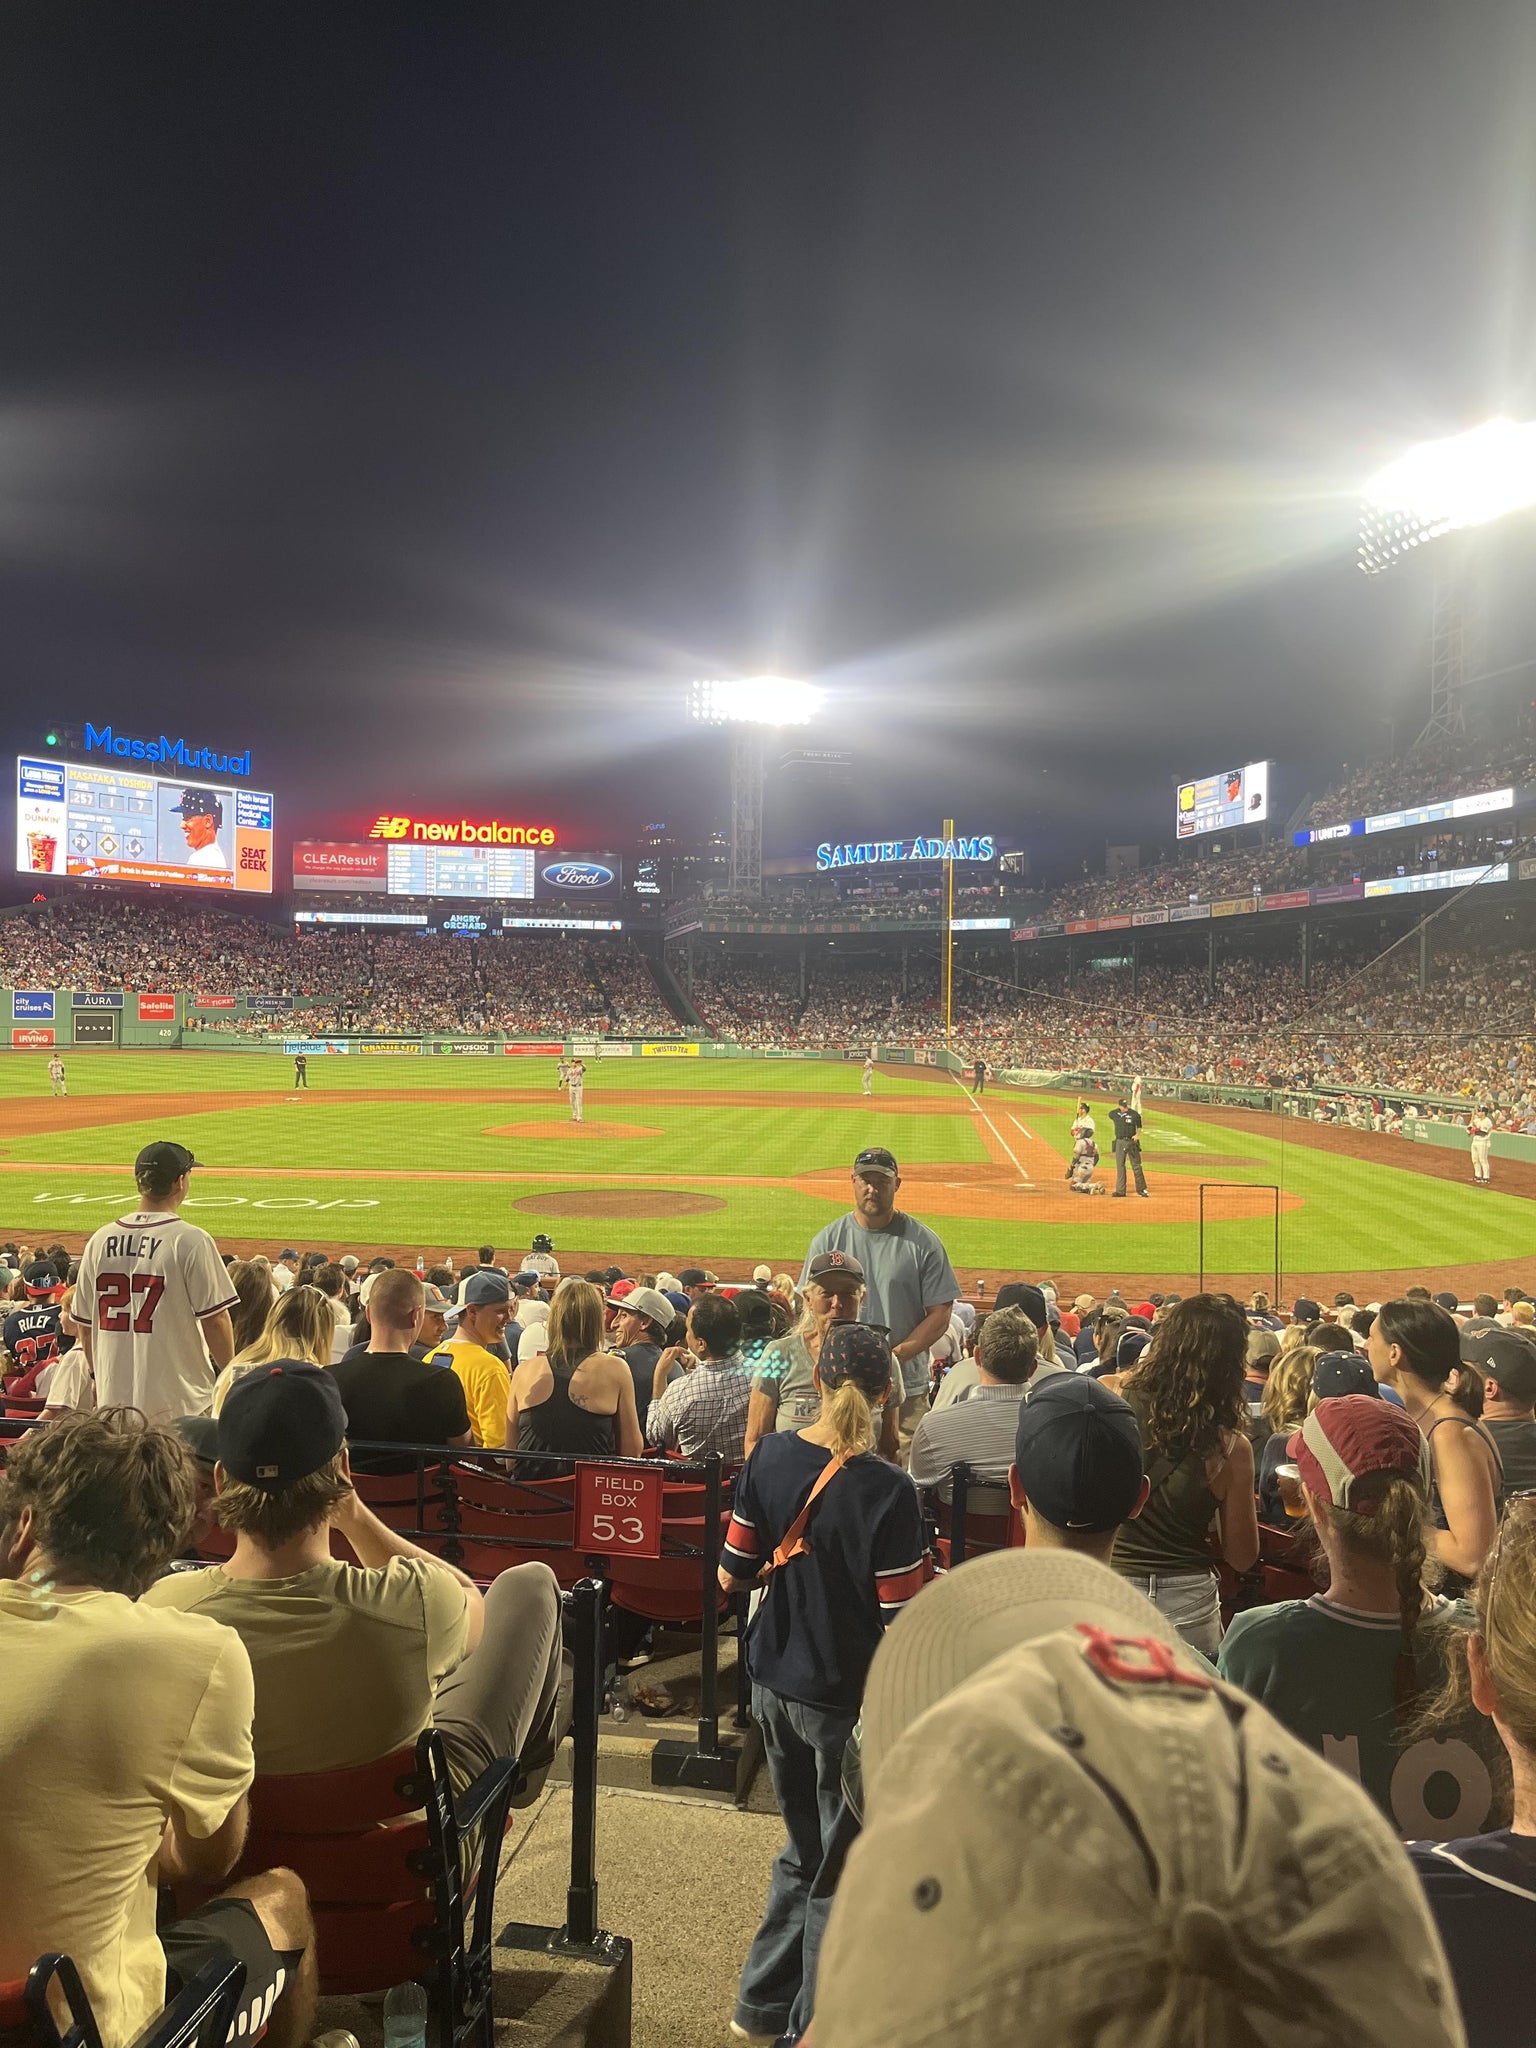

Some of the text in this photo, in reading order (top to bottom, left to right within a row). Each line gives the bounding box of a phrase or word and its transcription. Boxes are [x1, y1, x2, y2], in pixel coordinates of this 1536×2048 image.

[85, 722, 250, 776] MassMutual
[69, 770, 153, 790] MASATAKA YOSHIDA
[71, 793, 93, 805] .257
[237, 792, 269, 804] Beth Israel
[237, 801, 270, 812] Deaconess
[25, 813, 60, 824] DUNKIN'
[237, 808, 262, 819] Medical
[237, 817, 259, 826] Center
[413, 822, 459, 842] new
[461, 820, 555, 845] balance
[1318, 824, 1351, 841] UNITED
[241, 847, 266, 860] SEAT
[303, 853, 377, 866] CLEAResult
[816, 836, 994, 871] SAMUEL ADAMS
[240, 859, 267, 872] GEEK
[556, 865, 600, 886] Ford
[449, 914, 481, 923] ANGRY
[443, 921, 488, 930] ORCHARD
[15, 997, 30, 1006] city
[140, 1002, 174, 1010] Safelite
[212, 998, 235, 1006] TICKET
[19, 1035, 49, 1043] IRVING
[159, 1029, 172, 1037] 420
[288, 1042, 321, 1052] jetBlue
[453, 1043, 489, 1051] wasabi
[652, 1045, 688, 1054] TWISTED TEA
[106, 1234, 163, 1260] RILEY
[96, 1272, 165, 1333] 27
[17, 1315, 52, 1333] RILEY
[595, 1476, 645, 1491] FIELD
[601, 1493, 637, 1508] BOX
[592, 1514, 644, 1544] 53
